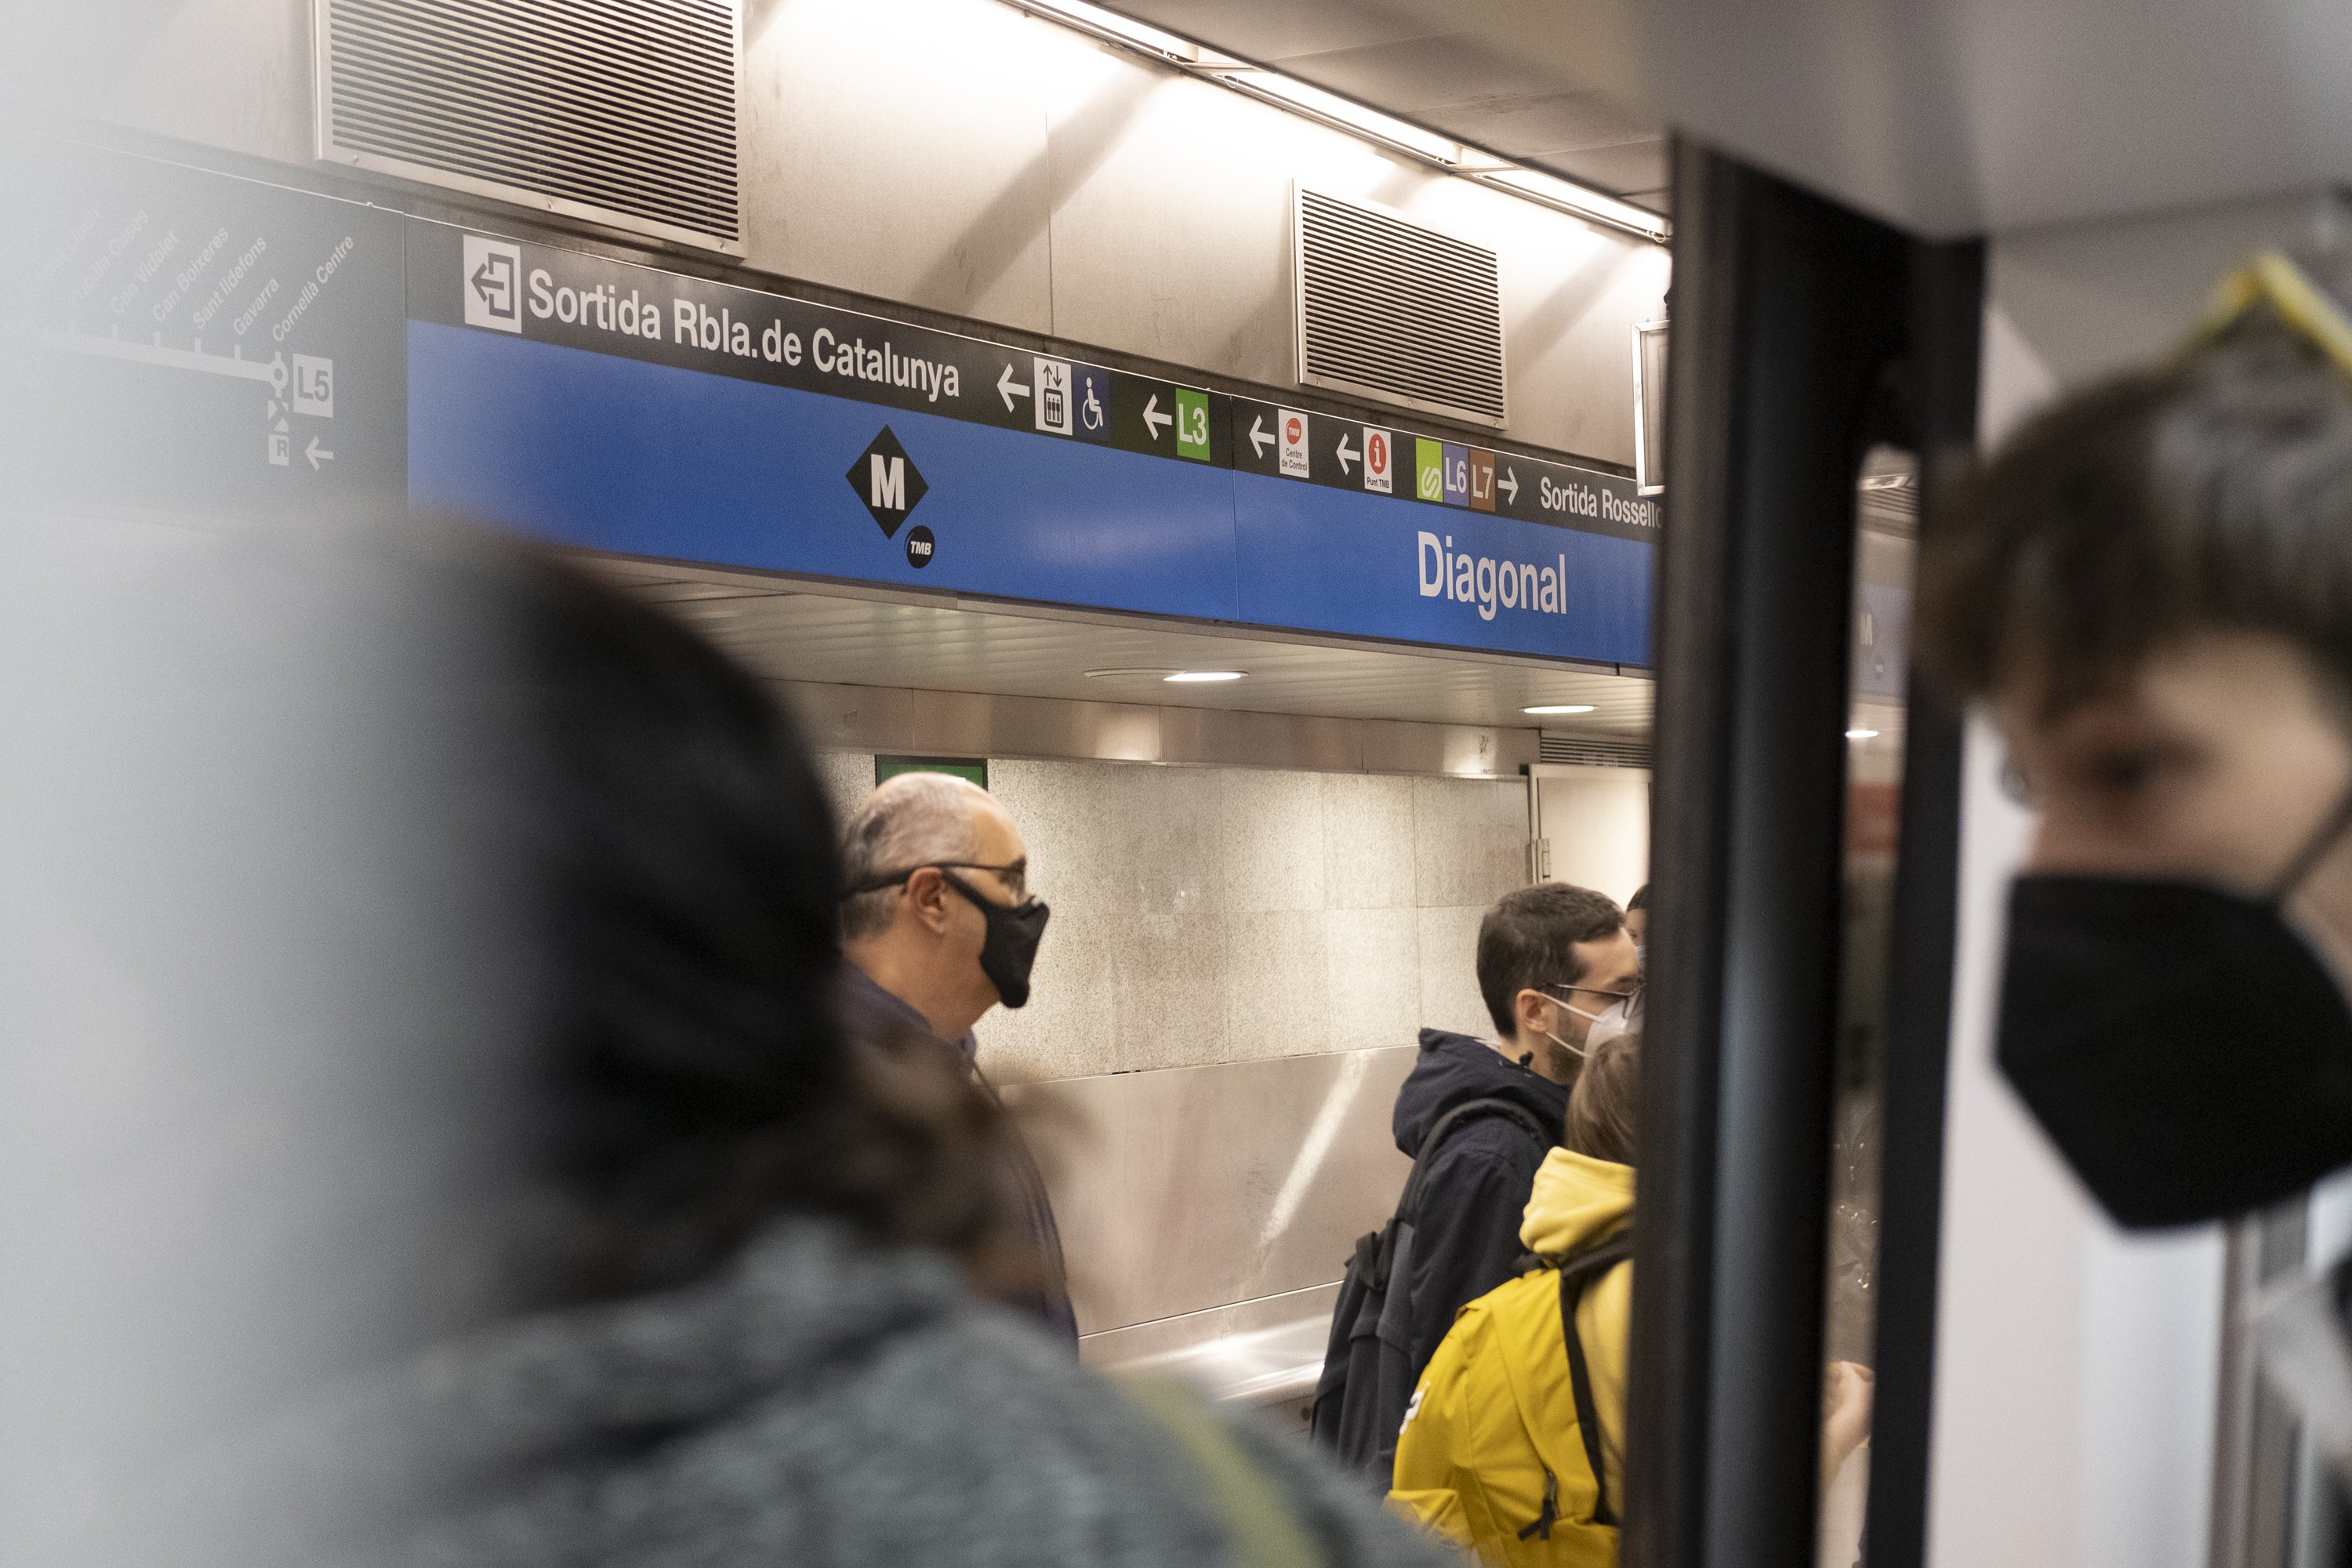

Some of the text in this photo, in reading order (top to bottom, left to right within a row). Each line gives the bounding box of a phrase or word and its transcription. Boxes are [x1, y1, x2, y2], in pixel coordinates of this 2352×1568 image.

[111, 230, 180, 314] Can Vidalet
[152, 227, 229, 322] Can Boixeres
[193, 237, 267, 329] Sant Ildefons
[272, 236, 354, 342] Cornellà Centre
[234, 278, 279, 335] Gavarra
[528, 269, 662, 340] Sortida
[811, 327, 960, 402] Catalunya
[298, 366, 329, 402] L5
[1178, 403, 1208, 446] L3
[1288, 426, 1300, 437] TMB
[1281, 459, 1307, 471] de Control
[1286, 448, 1302, 459] Centre
[871, 453, 905, 510] M
[1367, 477, 1390, 488] Punt TMB
[1445, 457, 1467, 493] L6
[1472, 464, 1493, 499] L7
[1541, 476, 1597, 517] Sortida
[910, 541, 931, 556] TMB
[1417, 531, 1566, 621] Diagonal
